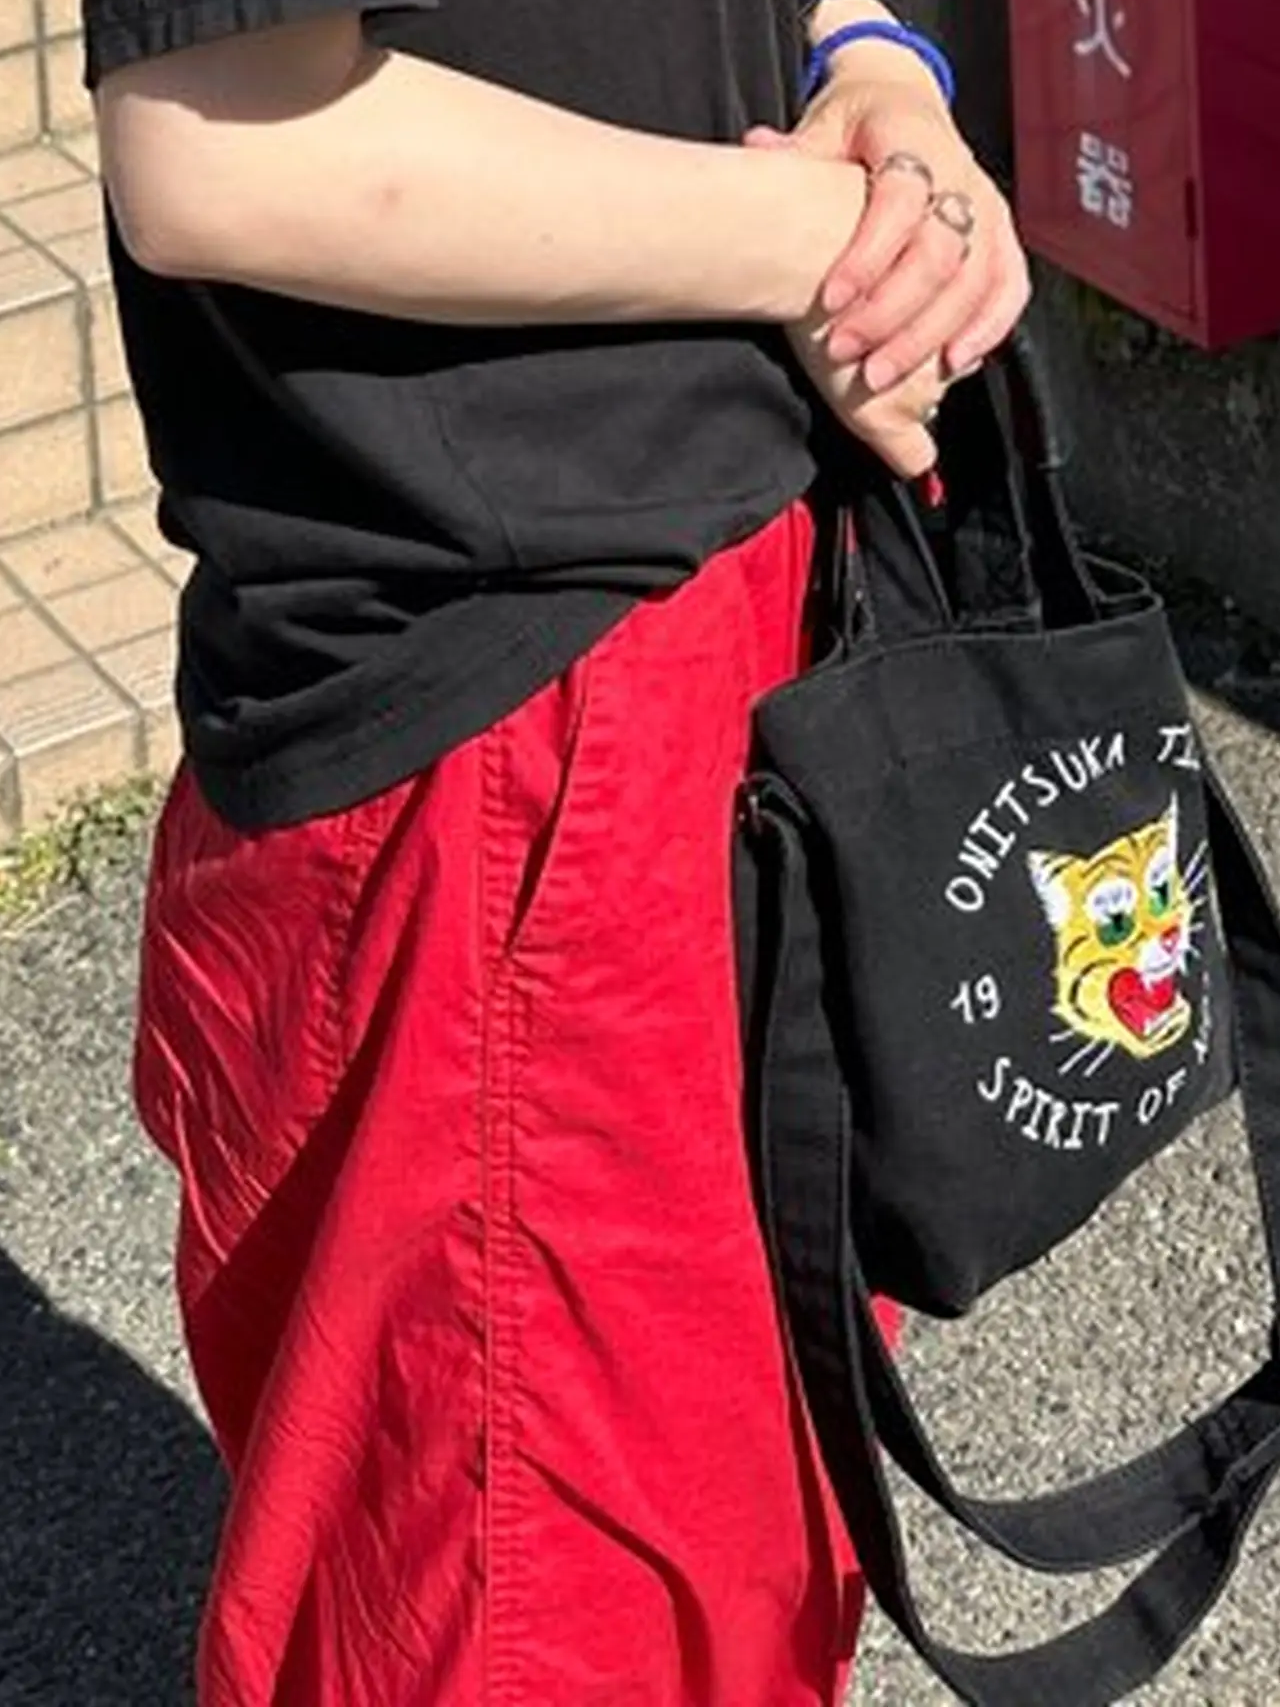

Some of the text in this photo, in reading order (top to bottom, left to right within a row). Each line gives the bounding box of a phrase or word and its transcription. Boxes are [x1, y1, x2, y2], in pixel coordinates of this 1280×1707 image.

[945, 722, 1202, 912] ONITSUKA TI
[950, 974, 1001, 1024] 19
[977, 1056, 1188, 1150] SPIRIT OF
